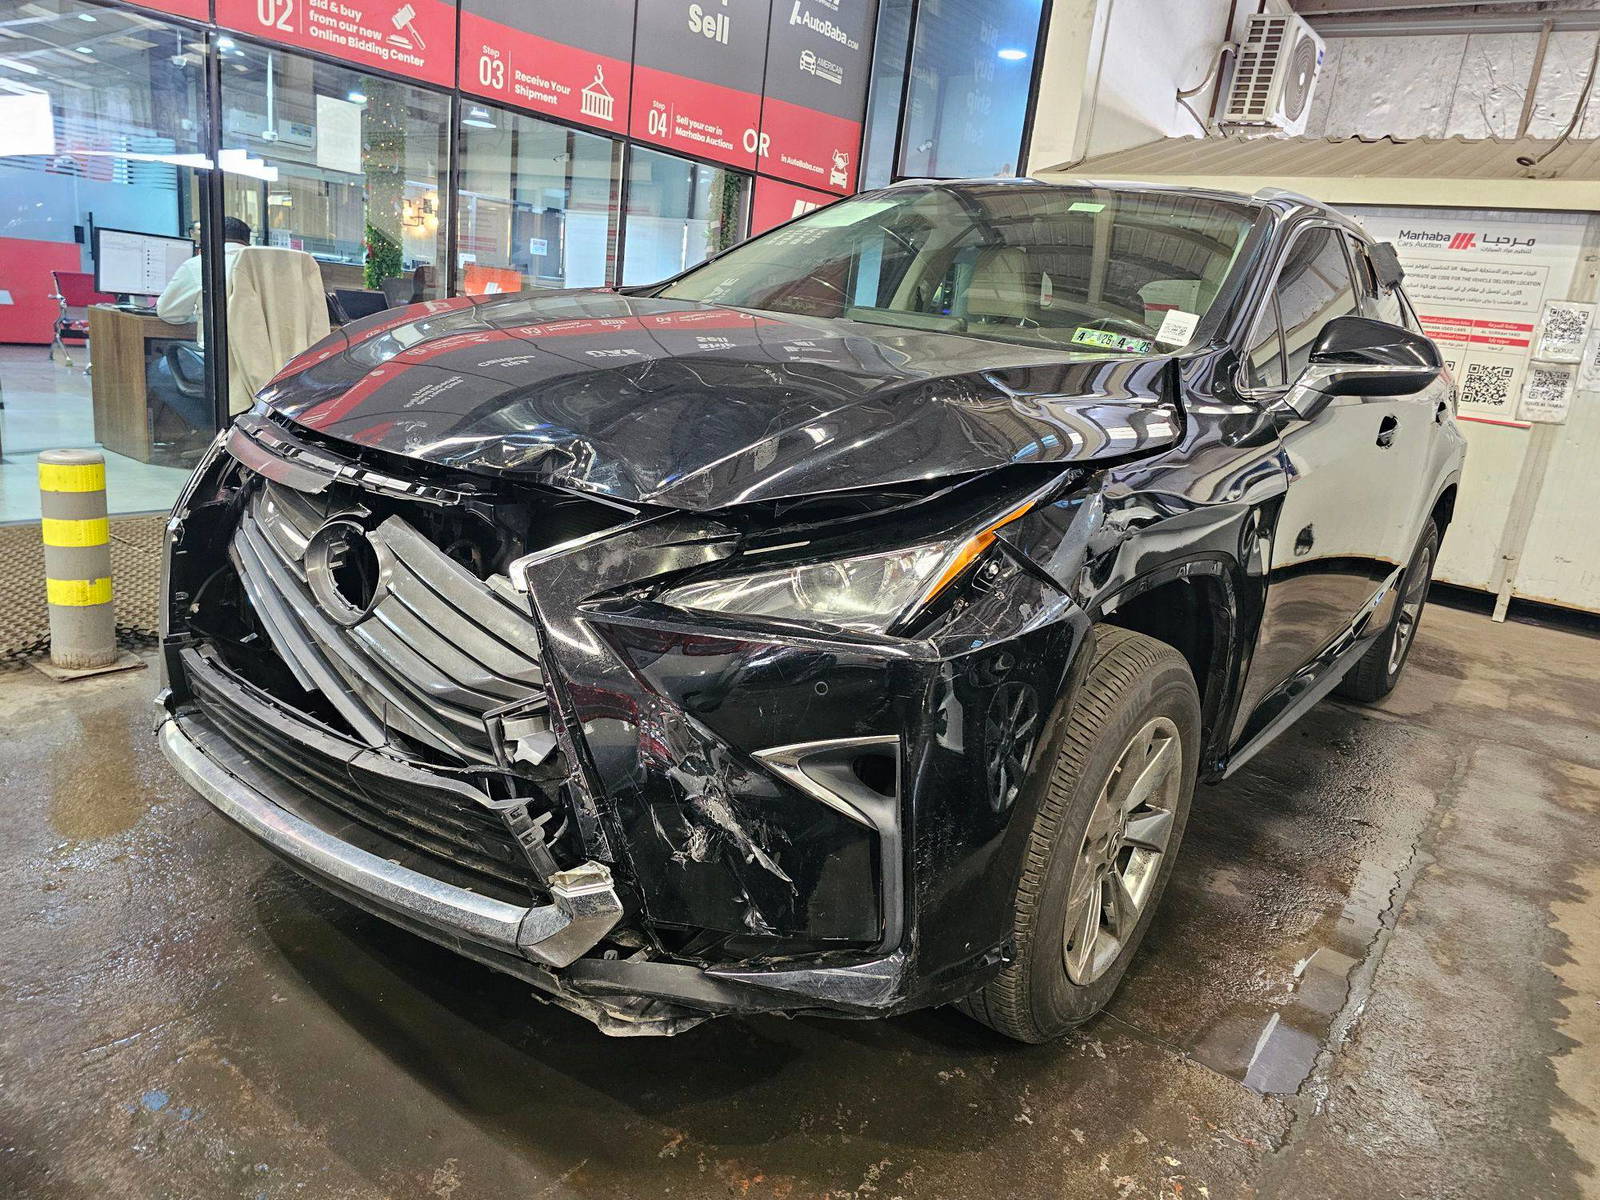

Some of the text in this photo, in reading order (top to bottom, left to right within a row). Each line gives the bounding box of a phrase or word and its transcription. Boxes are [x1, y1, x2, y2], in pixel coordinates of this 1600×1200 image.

[257, 0, 294, 33] 02
[330, 3, 339, 13] &
[340, 4, 362, 22] buy
[309, 10, 382, 41] from our new
[688, 3, 730, 45] Sell
[309, 26, 425, 67] Online Bidding Center
[482, 44, 500, 59] Step
[479, 55, 504, 90] 03
[515, 70, 571, 95] Receive Your
[514, 84, 558, 105] Shipment
[652, 99, 666, 112] Step
[648, 109, 668, 138] 04
[675, 114, 723, 136] Sell your car in
[675, 127, 734, 151] Marhaba Auctions
[742, 128, 771, 158] OR
[780, 153, 787, 162] in
[1398, 229, 1451, 241] Marhaba
[1415, 241, 1442, 249] Auction
[1516, 279, 1541, 287] LOCATION
[1117, 337, 1152, 353] 4 26
